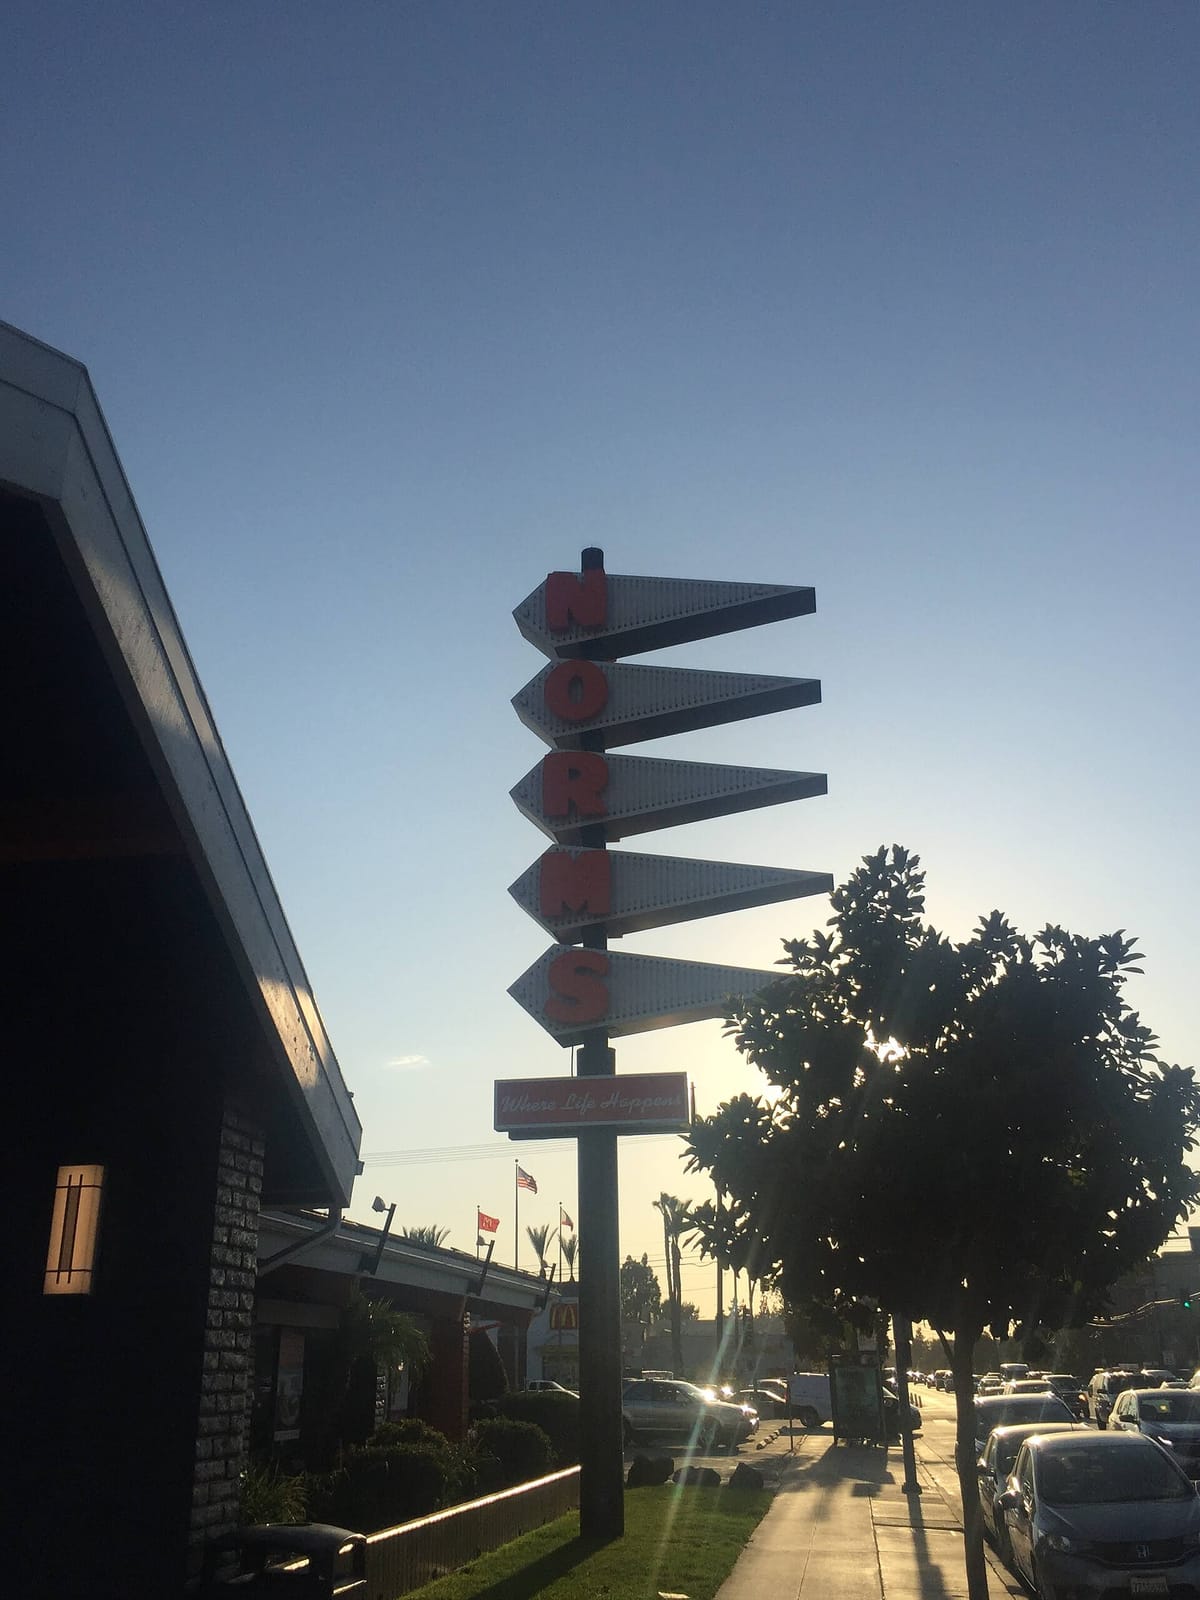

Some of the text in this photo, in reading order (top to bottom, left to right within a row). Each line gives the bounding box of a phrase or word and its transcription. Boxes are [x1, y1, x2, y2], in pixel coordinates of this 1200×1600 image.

[539, 569, 612, 1025] NORMS
[502, 1093, 555, 1113] Where
[560, 1091, 595, 1116] Life
